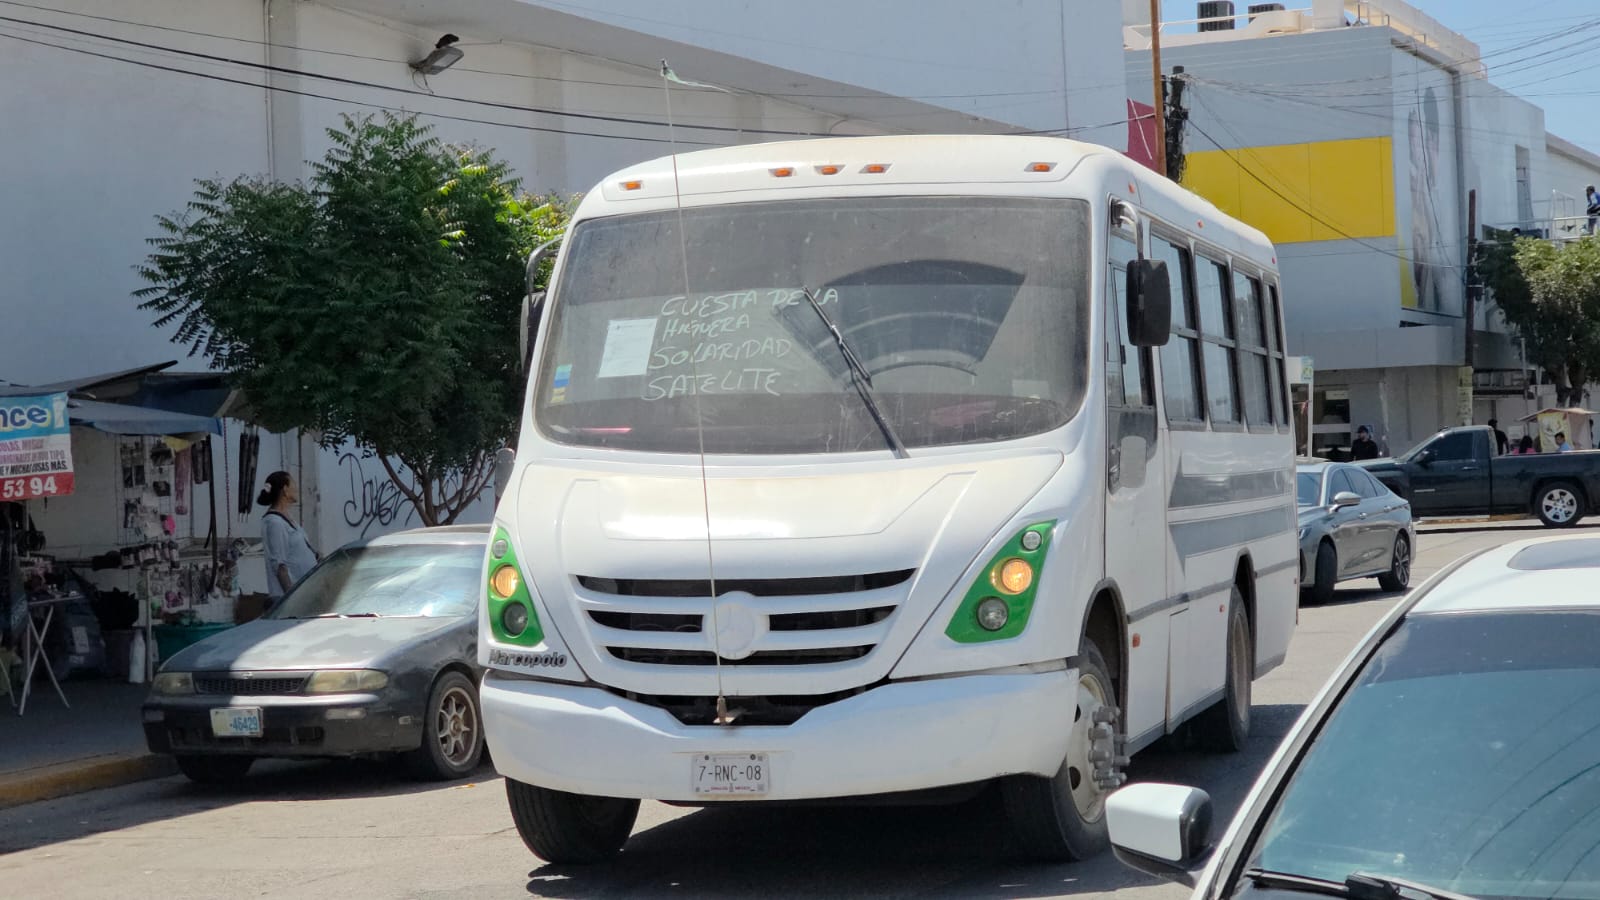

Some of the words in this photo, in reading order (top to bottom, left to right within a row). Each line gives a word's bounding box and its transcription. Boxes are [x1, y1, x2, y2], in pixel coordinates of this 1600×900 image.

[661, 290, 757, 318] CUESTA
[767, 289, 804, 306] DE
[640, 368, 781, 401] SATELITE
[3, 479, 25, 498] 53
[30, 476, 57, 496] 94
[698, 765, 762, 782] 7-RNC-08
